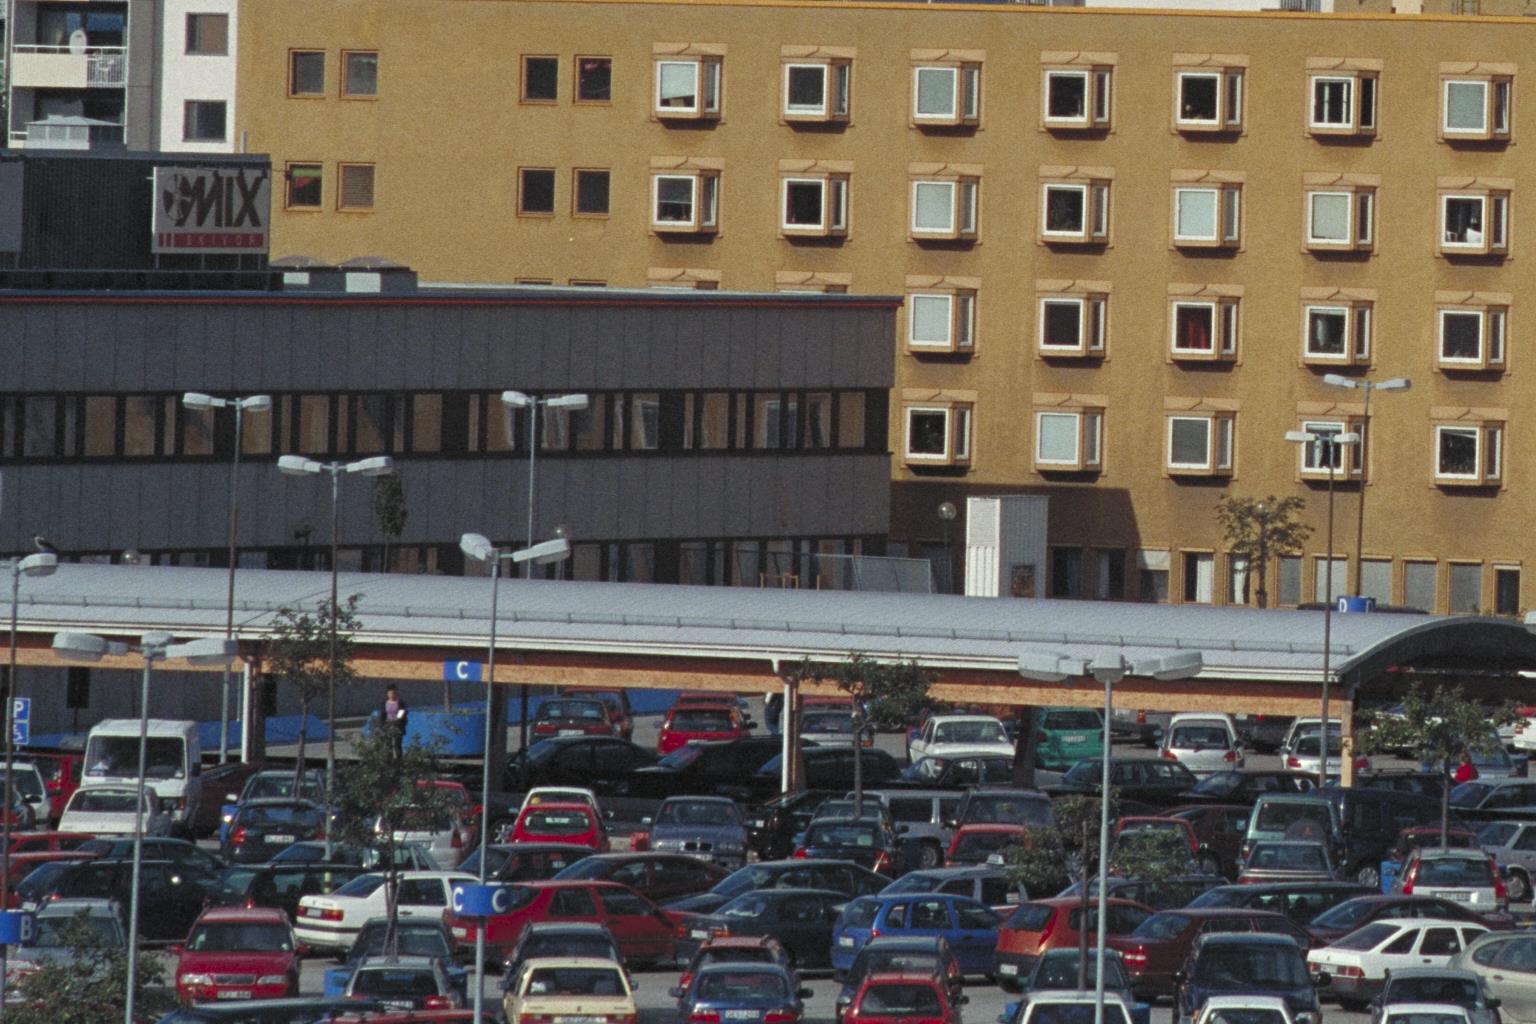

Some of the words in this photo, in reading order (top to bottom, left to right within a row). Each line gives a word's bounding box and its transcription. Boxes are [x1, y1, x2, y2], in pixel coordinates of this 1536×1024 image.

[456, 662, 469, 679] C
[14, 701, 24, 718] P
[452, 887, 464, 912] C
[492, 888, 507, 914] C
[20, 916, 32, 941] B
